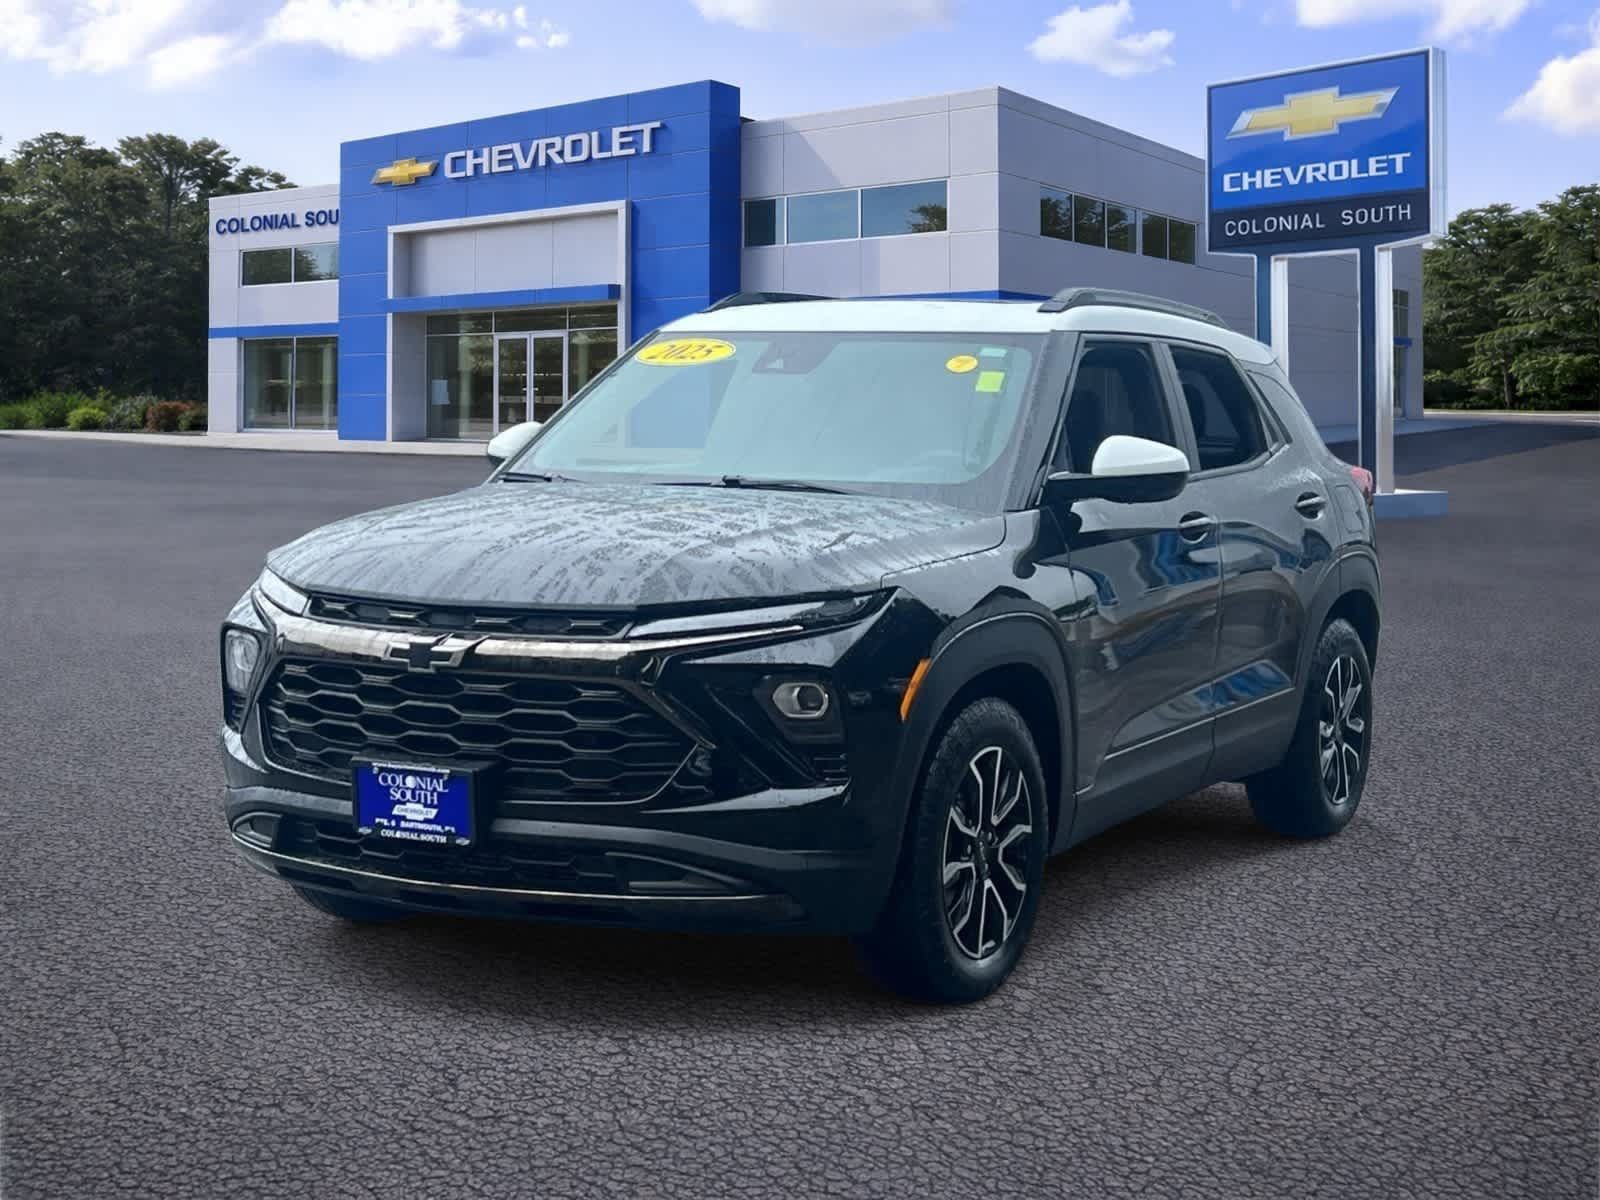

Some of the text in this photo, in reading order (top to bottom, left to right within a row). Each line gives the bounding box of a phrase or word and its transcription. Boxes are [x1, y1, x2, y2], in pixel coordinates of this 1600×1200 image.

[443, 121, 662, 179] CHEVROLET
[1223, 152, 1411, 192] CHEVROLET
[215, 212, 300, 236] COLONIAL
[1225, 204, 1411, 236] COLONIAL SOUTH
[646, 342, 724, 360] 2025
[378, 773, 449, 792] COLONIAL
[390, 788, 438, 805] SOUTH
